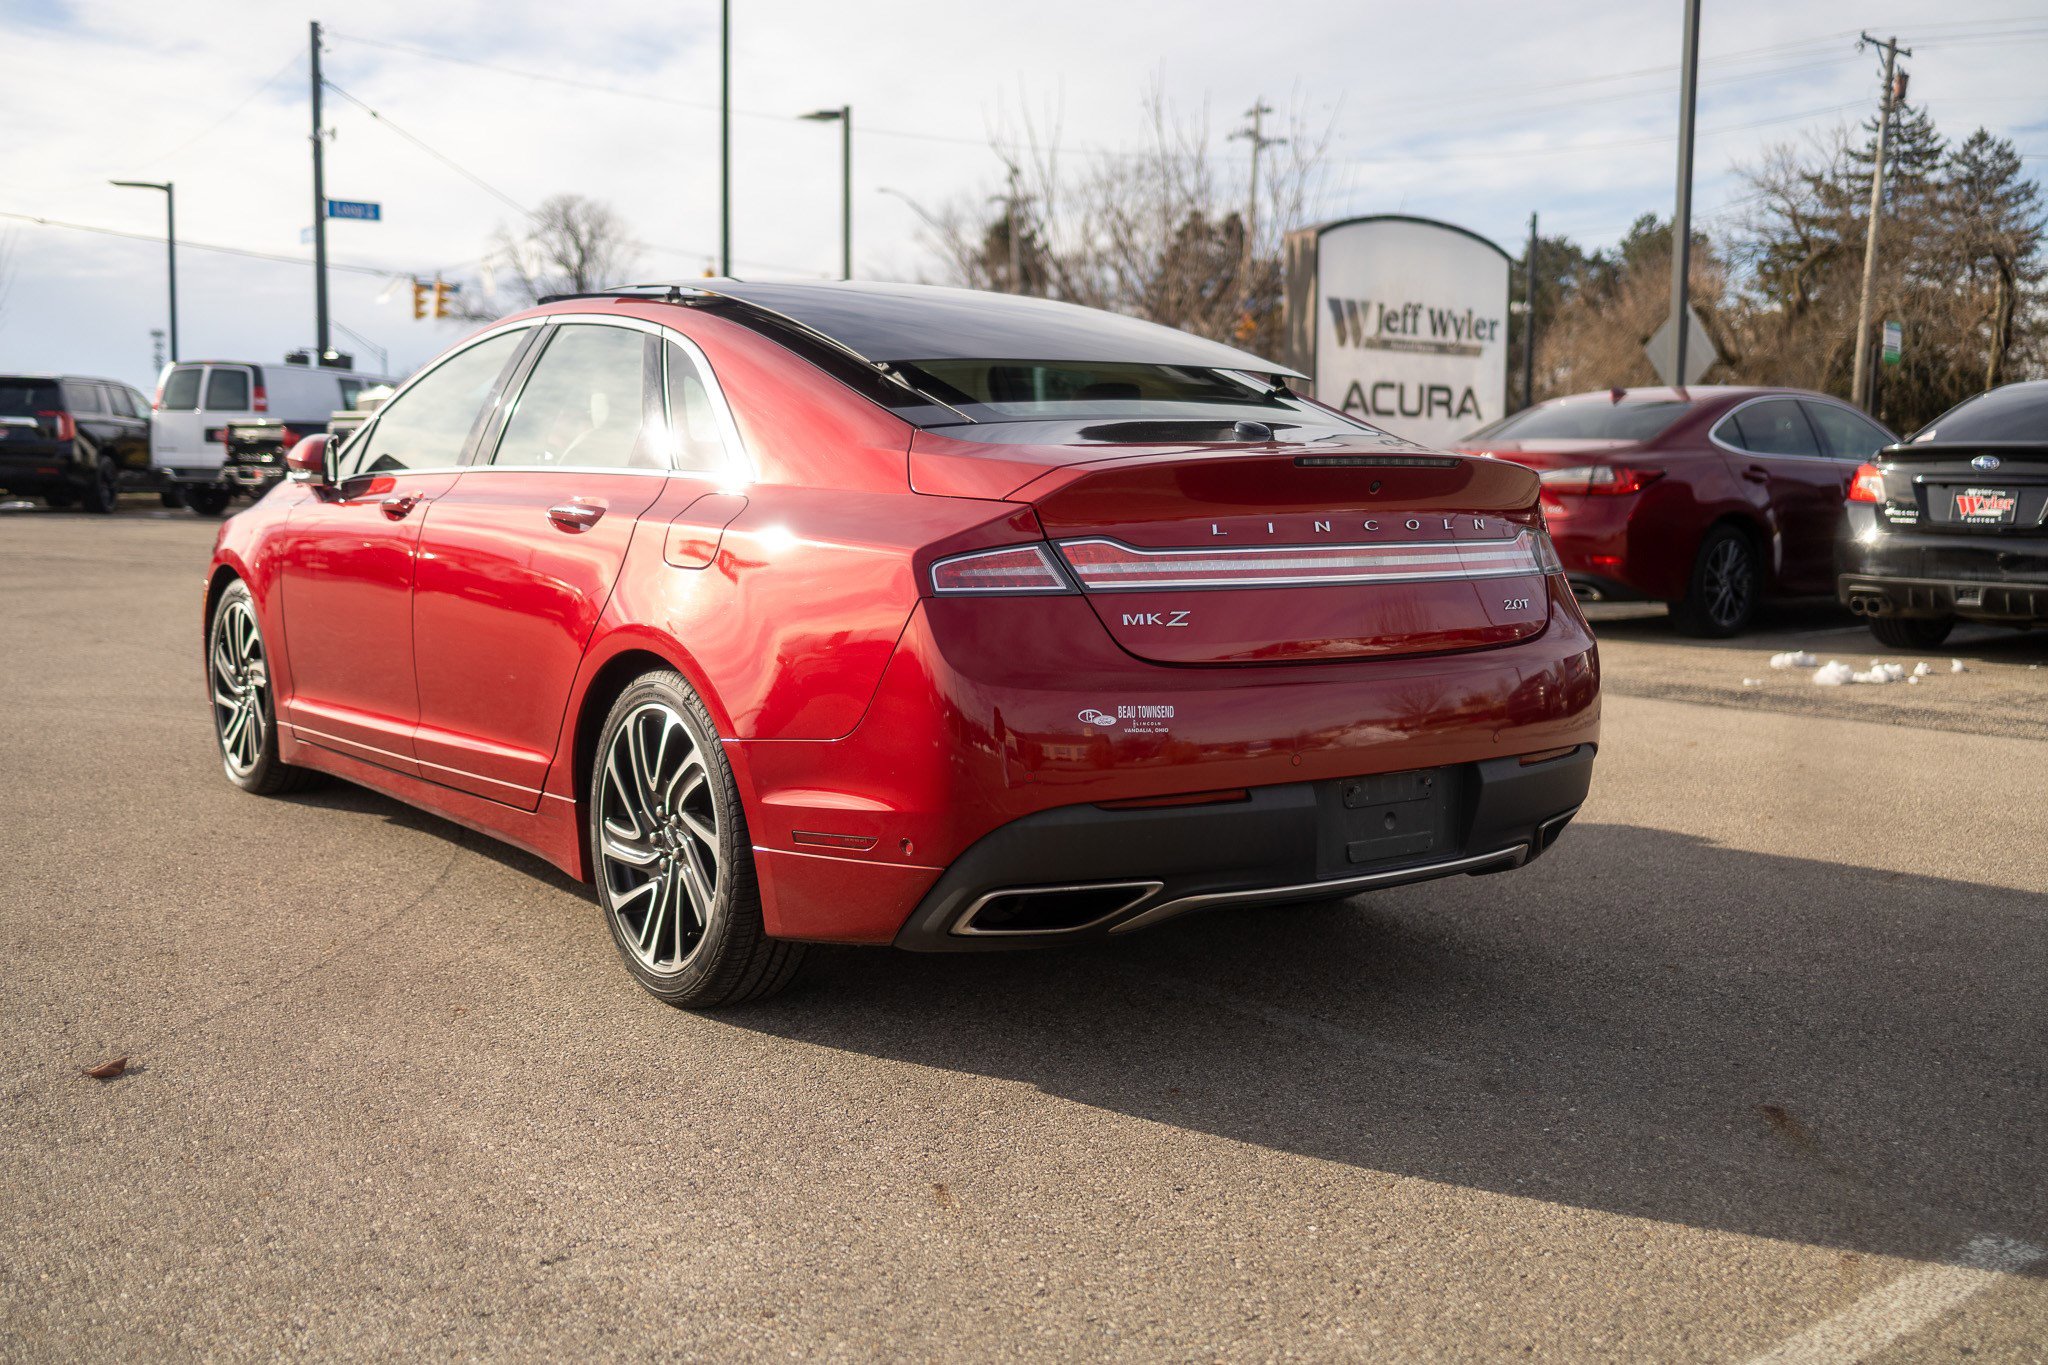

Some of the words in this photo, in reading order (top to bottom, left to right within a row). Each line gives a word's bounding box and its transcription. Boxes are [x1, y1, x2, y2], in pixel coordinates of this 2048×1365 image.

[1376, 302, 1424, 335] Jeff
[1429, 307, 1500, 344] Wyler
[1341, 378, 1482, 420] ACURA
[1956, 495, 2015, 516] Wyler
[1212, 519, 1485, 535] LINCOLN
[1503, 599, 1529, 610] 2.0T
[1122, 610, 1191, 627] MKZ
[1118, 705, 1136, 719] BEAU
[1138, 705, 1175, 718] TOWNSEND
